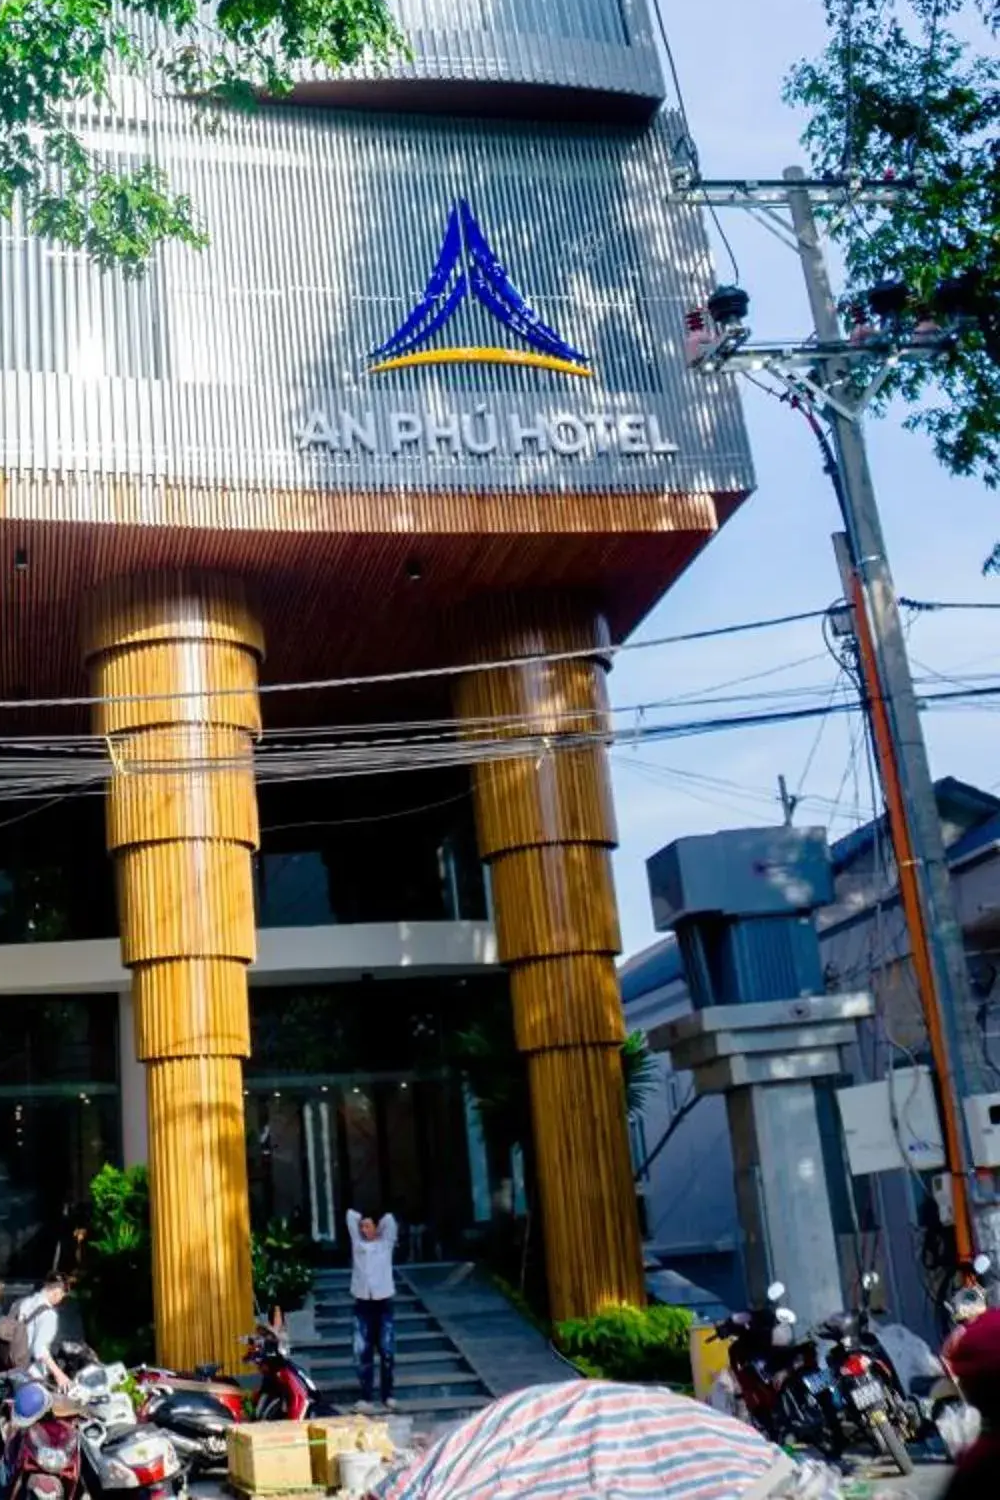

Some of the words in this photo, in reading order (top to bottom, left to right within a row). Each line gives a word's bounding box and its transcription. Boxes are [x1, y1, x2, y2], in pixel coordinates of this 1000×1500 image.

[295, 410, 376, 452] AN
[391, 403, 497, 453] PHÚ
[509, 411, 680, 453] HOTEL
